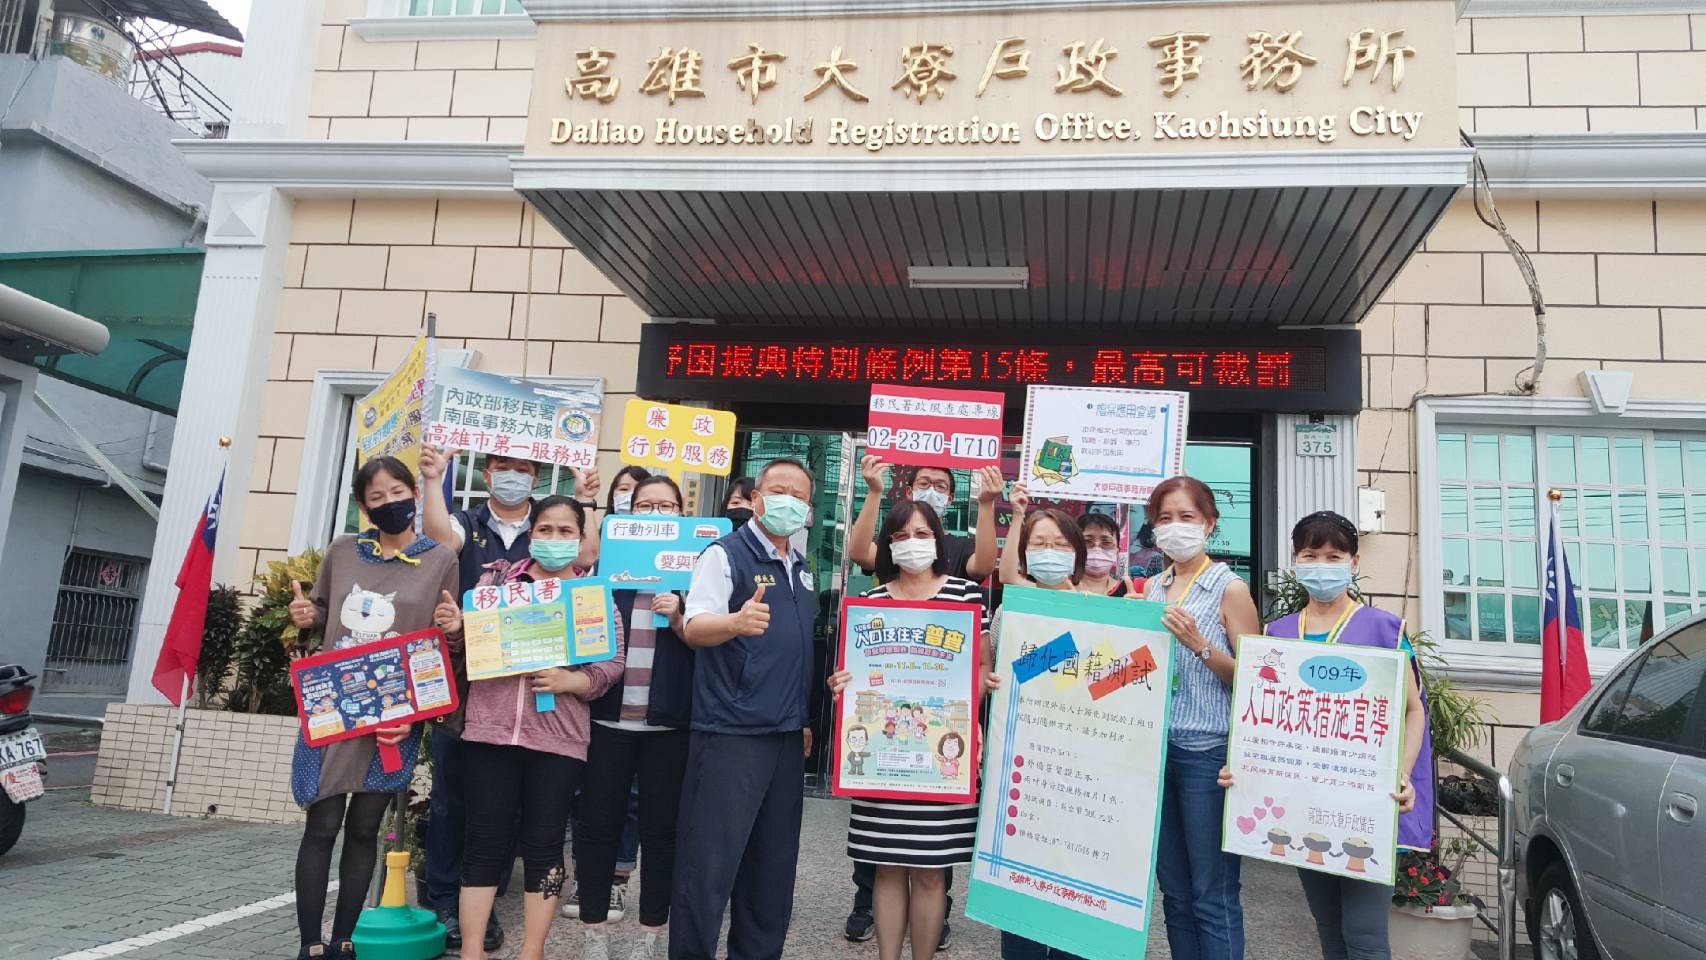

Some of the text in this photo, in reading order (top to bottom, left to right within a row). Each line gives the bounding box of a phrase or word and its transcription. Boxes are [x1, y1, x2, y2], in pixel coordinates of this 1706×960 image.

[564, 28, 1417, 104] 高雄市大寮戶政事務所
[550, 105, 1423, 152] Daliao Household Registration Office, Kaohsiung City
[443, 407, 553, 440] 南區事務大隊
[648, 407, 713, 434] 廉政
[429, 424, 592, 467] 高雄市第一服務站
[627, 436, 729, 467] 行動服務
[868, 428, 998, 457] 02-2370-1710
[1302, 441, 1333, 453] 375
[613, 521, 676, 538] 行動列車
[474, 579, 560, 609] 移民署
[856, 624, 965, 654] 人口及住宅普查
[1018, 641, 1152, 691] 歸化國籍測試
[1308, 664, 1363, 683] 109年
[1241, 685, 1390, 748] 人口政策措施宣導
